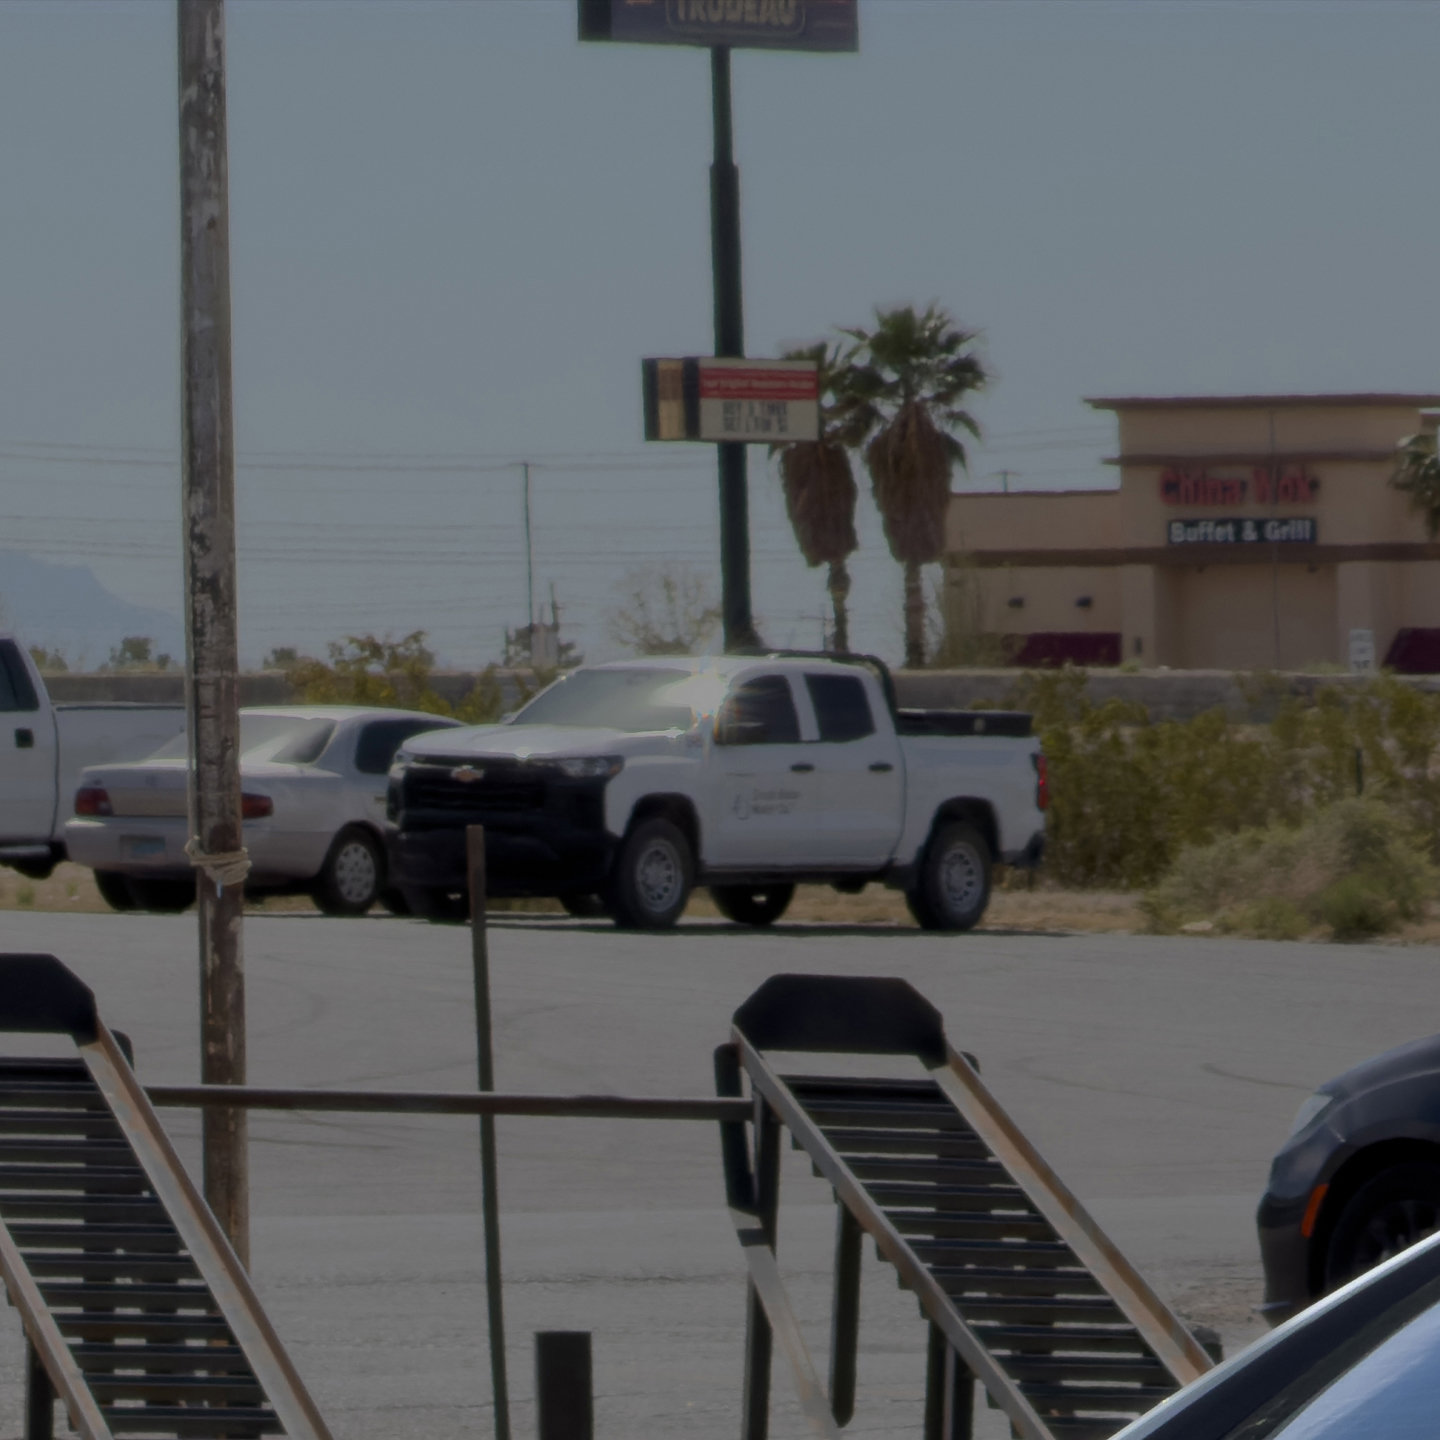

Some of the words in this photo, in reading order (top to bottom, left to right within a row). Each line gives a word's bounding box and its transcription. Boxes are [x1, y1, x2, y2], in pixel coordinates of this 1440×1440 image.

[1160, 466, 1242, 505] China
[1170, 521, 1235, 543] Buffet
[1241, 520, 1258, 542] &
[1263, 519, 1312, 542] Grill
